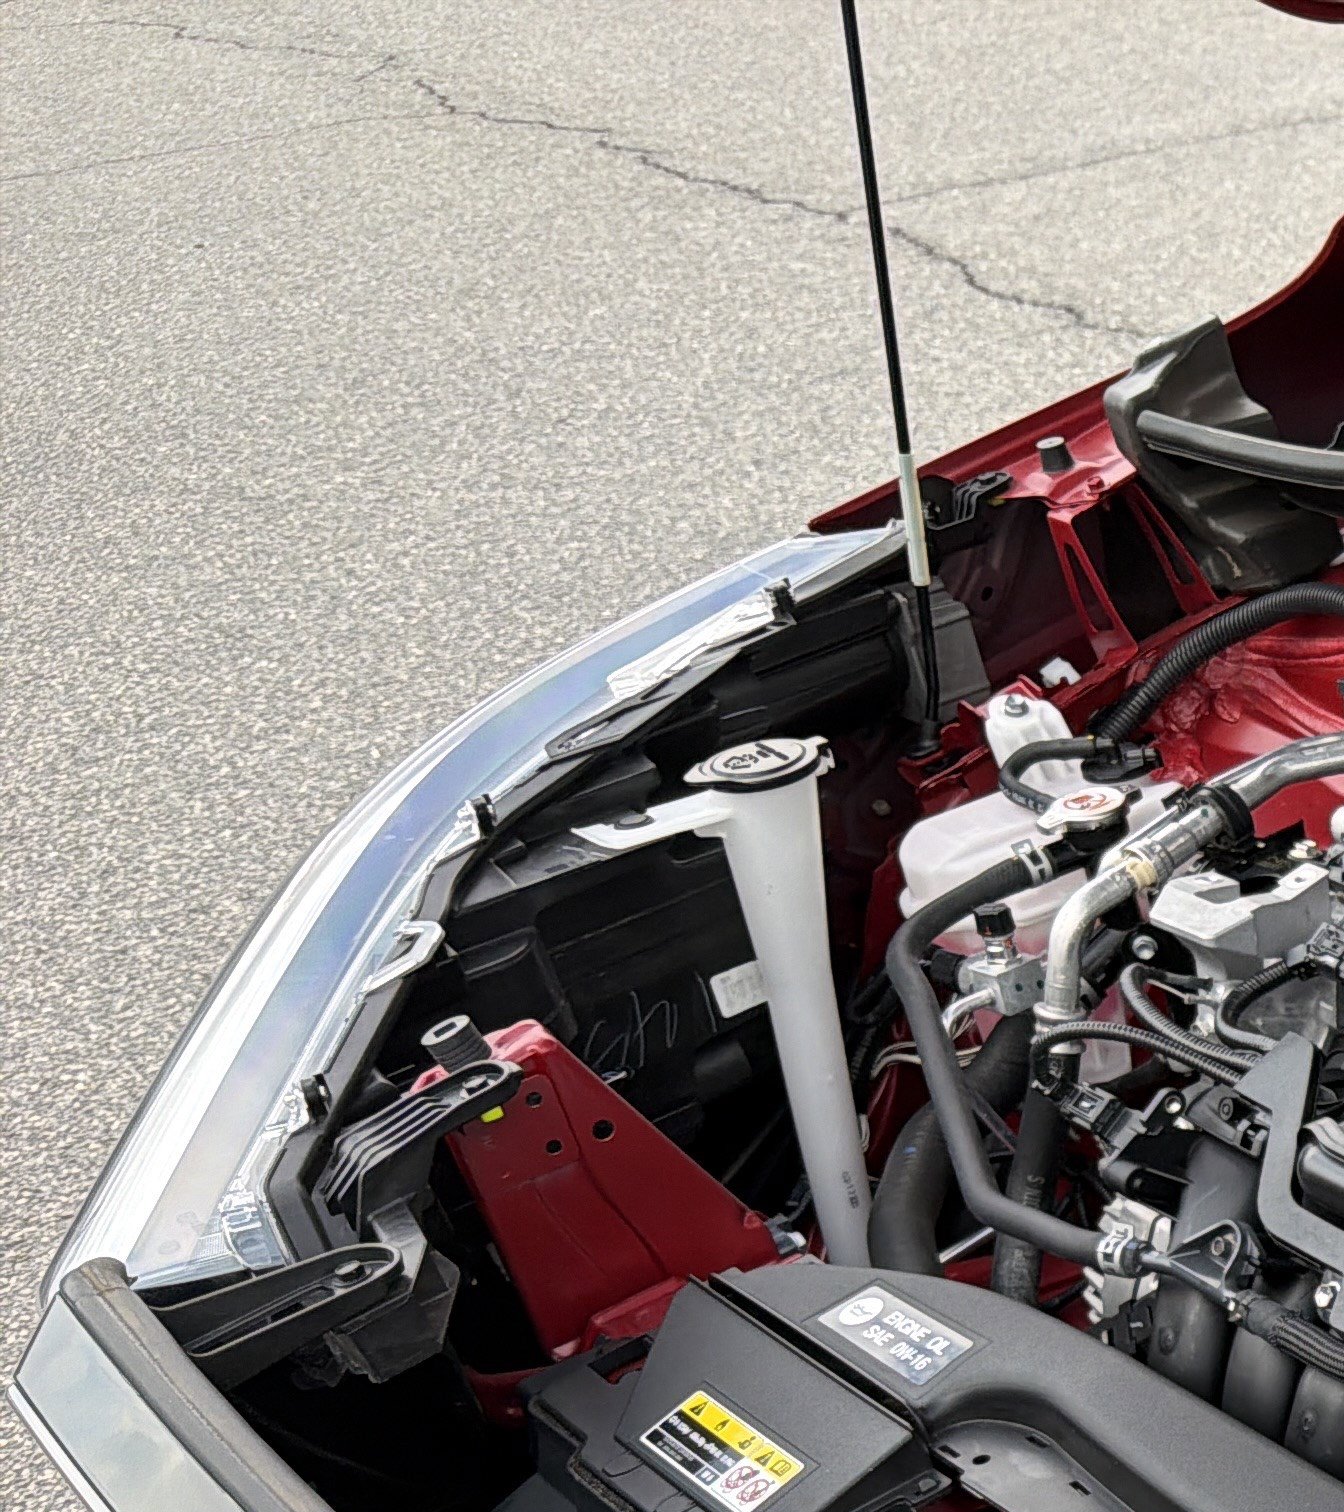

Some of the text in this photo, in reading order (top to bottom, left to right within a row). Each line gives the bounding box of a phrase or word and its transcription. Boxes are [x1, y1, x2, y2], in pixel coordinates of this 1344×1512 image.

[863, 1324, 895, 1346] SAE
[882, 1311, 951, 1356] ENGINE OIL
